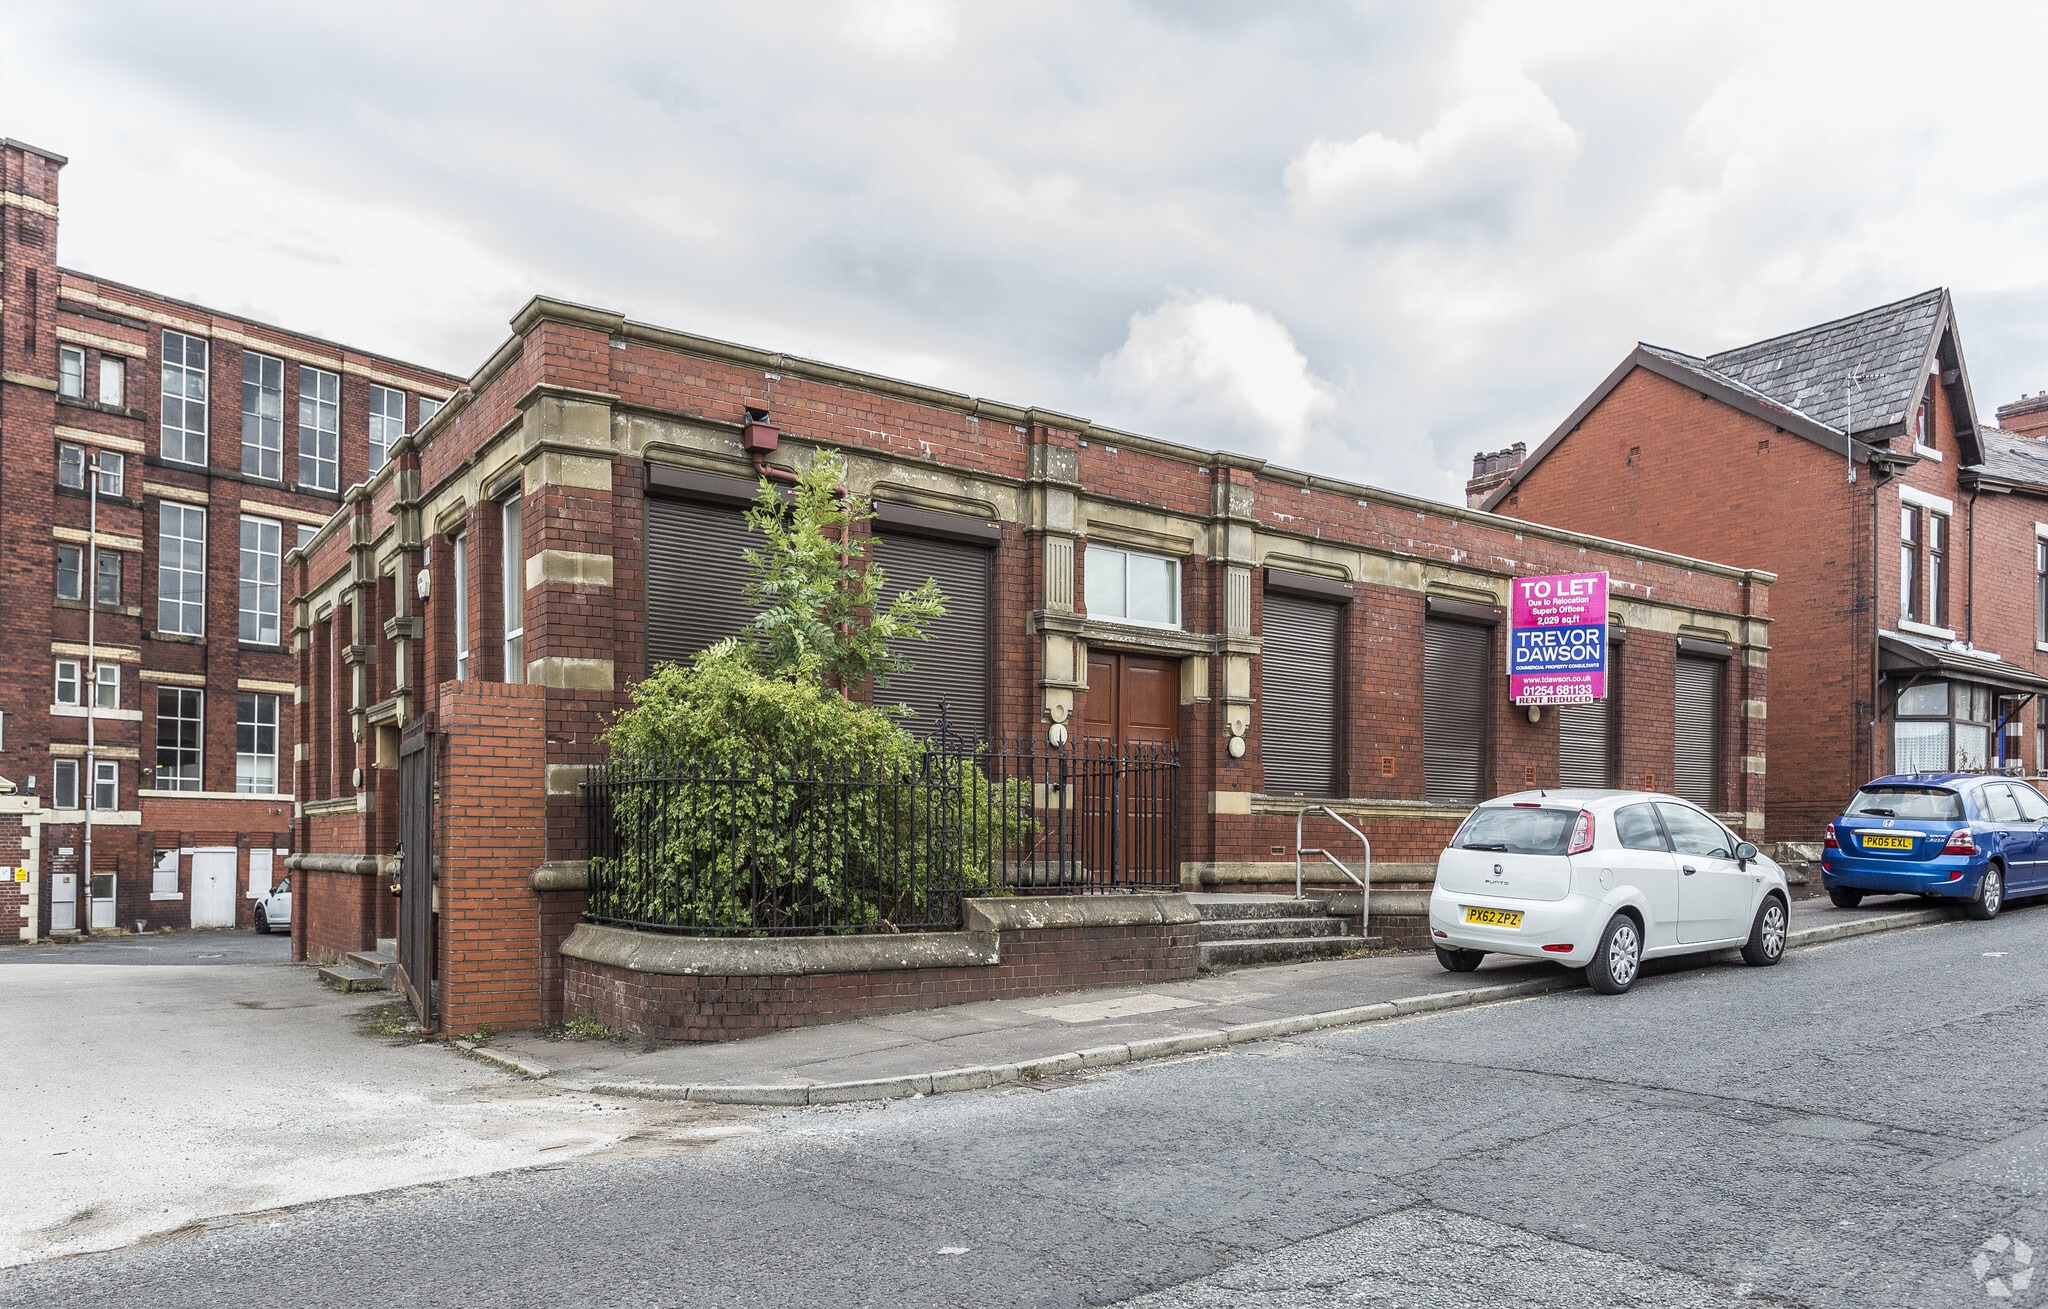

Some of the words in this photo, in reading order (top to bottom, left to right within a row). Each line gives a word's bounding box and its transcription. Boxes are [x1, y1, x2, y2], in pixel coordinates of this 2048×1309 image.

[1520, 581, 1551, 599] TO
[1557, 578, 1598, 597] LET
[1552, 597, 1590, 605] Relocation
[1532, 606, 1558, 616] Superb
[1537, 616, 1560, 626] 2,029
[1562, 614, 1580, 624] sq.ft
[1517, 628, 1600, 647] TREVOR
[1516, 645, 1600, 663] DAWSON
[1523, 675, 1592, 684] www.tdawson.co.uk
[1523, 686, 1554, 696] 01254
[1556, 684, 1592, 695] 681133
[1867, 837, 1890, 847] PK05
[1891, 838, 1908, 848] EXL
[1470, 910, 1496, 922] PX62
[1497, 912, 1518, 925] ZPZ
